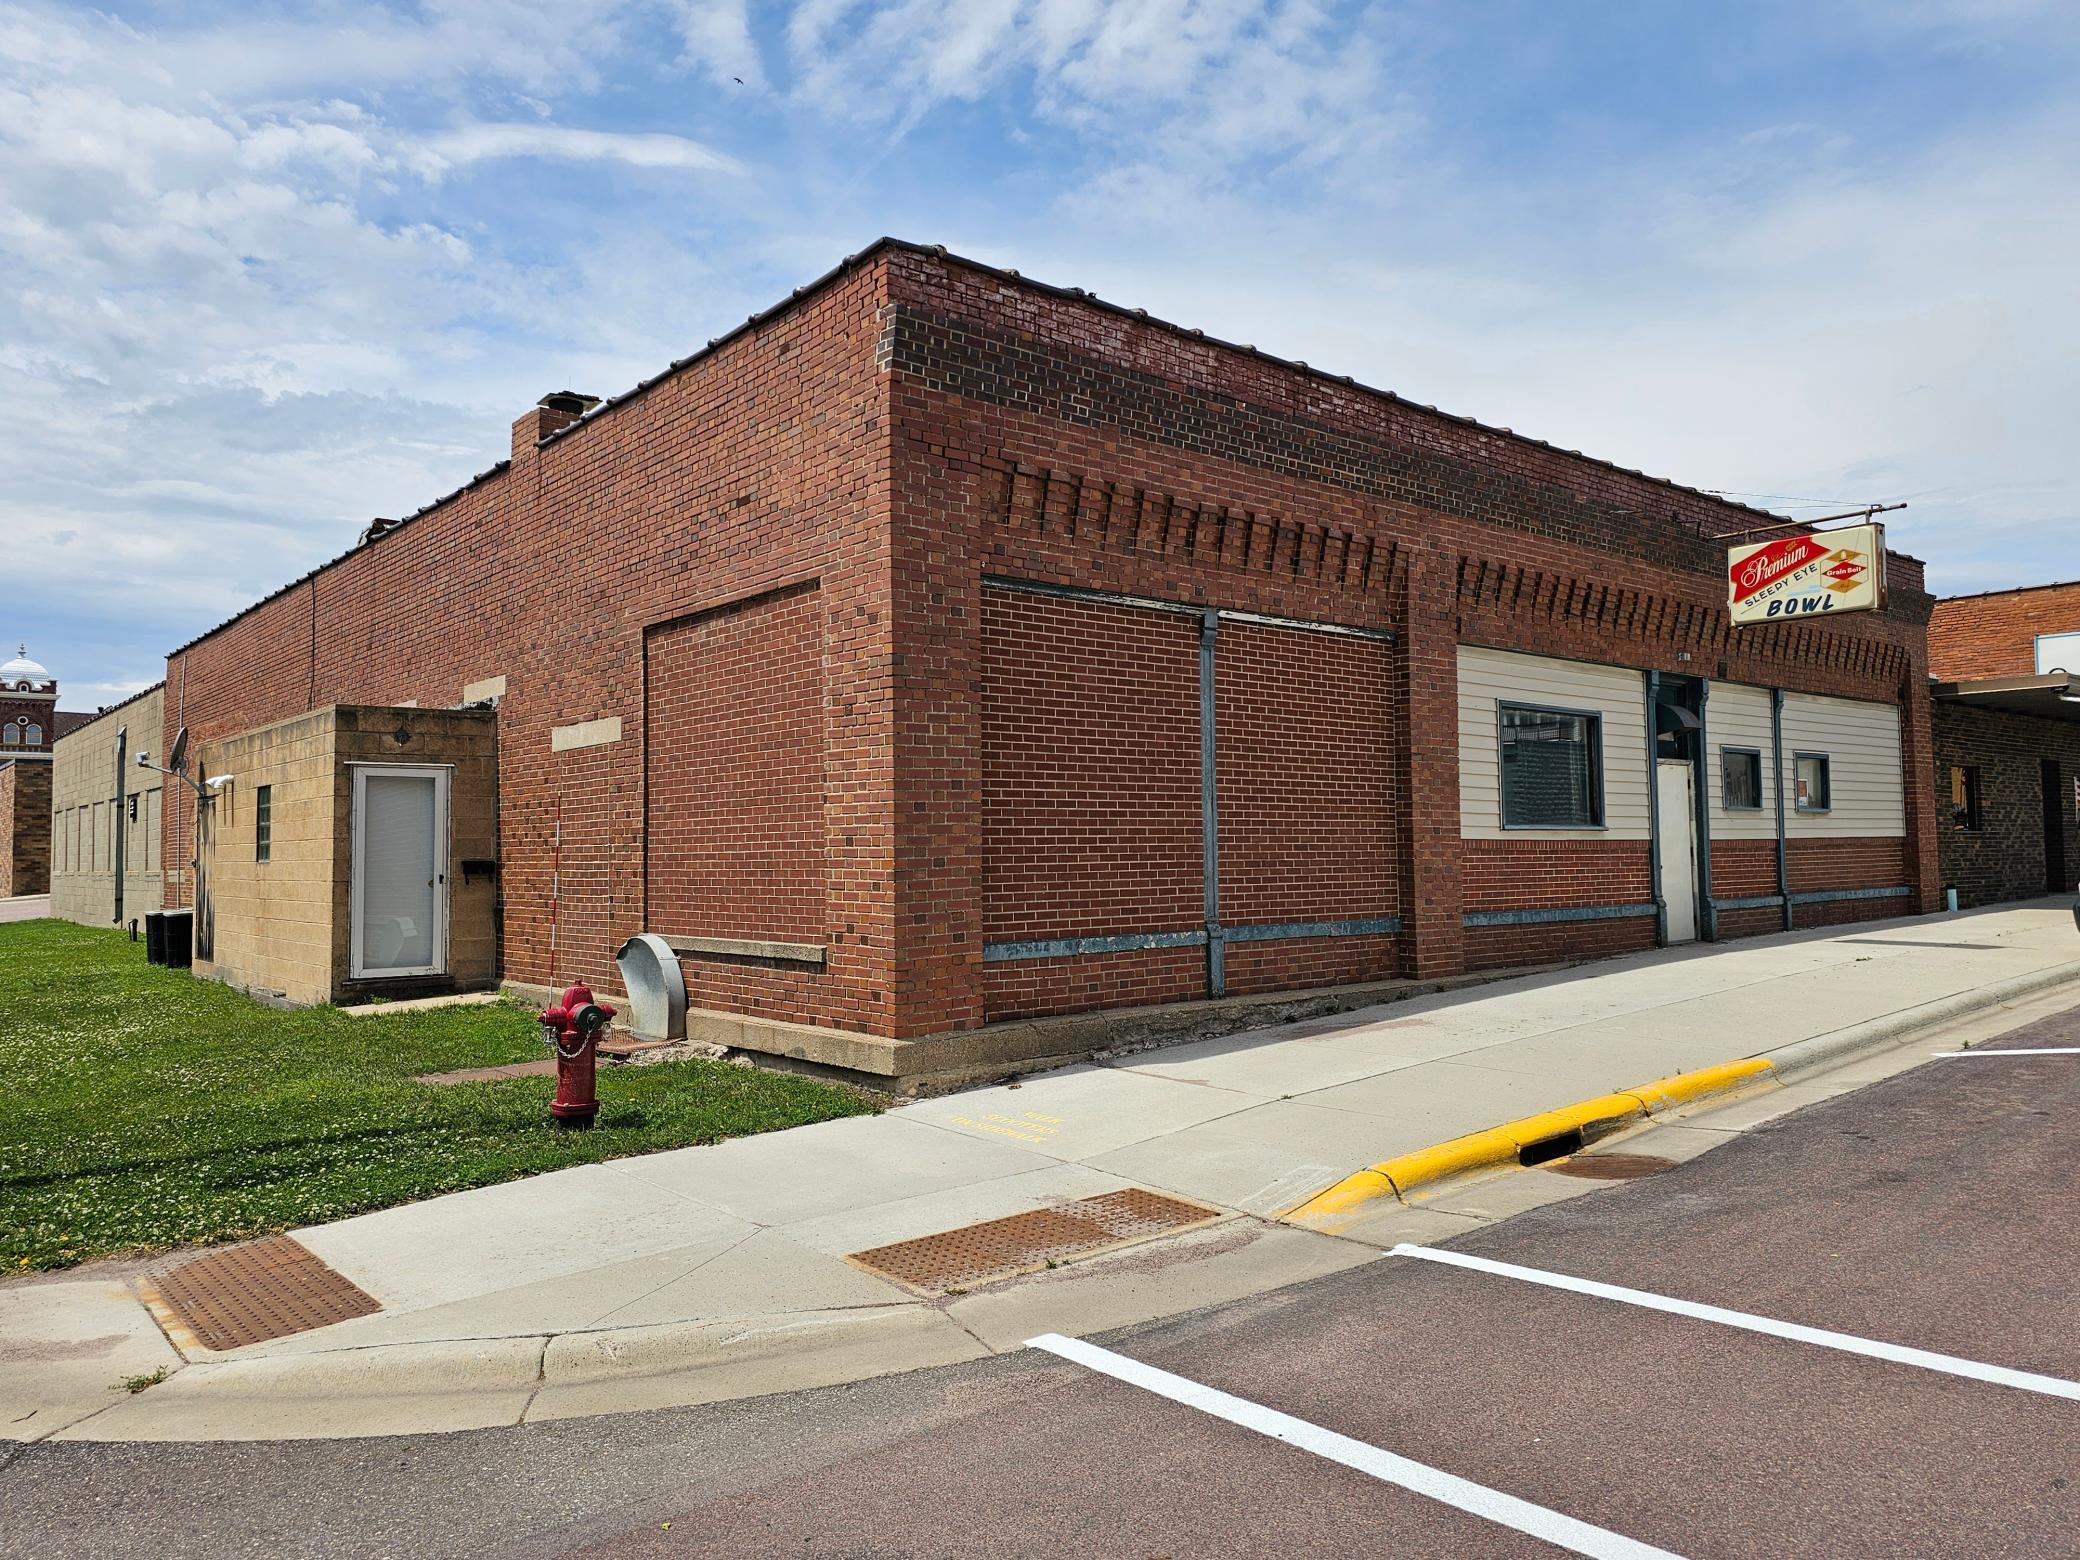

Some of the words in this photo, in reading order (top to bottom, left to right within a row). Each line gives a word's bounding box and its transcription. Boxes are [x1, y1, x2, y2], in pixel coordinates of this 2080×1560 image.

[1741, 545, 1809, 588] Premium
[1826, 568, 1847, 576] Grain
[1847, 566, 1862, 574] Belt
[1745, 578, 1789, 607] SLEEPY
[1793, 563, 1818, 581] EYE
[1766, 593, 1835, 617] BOWL
